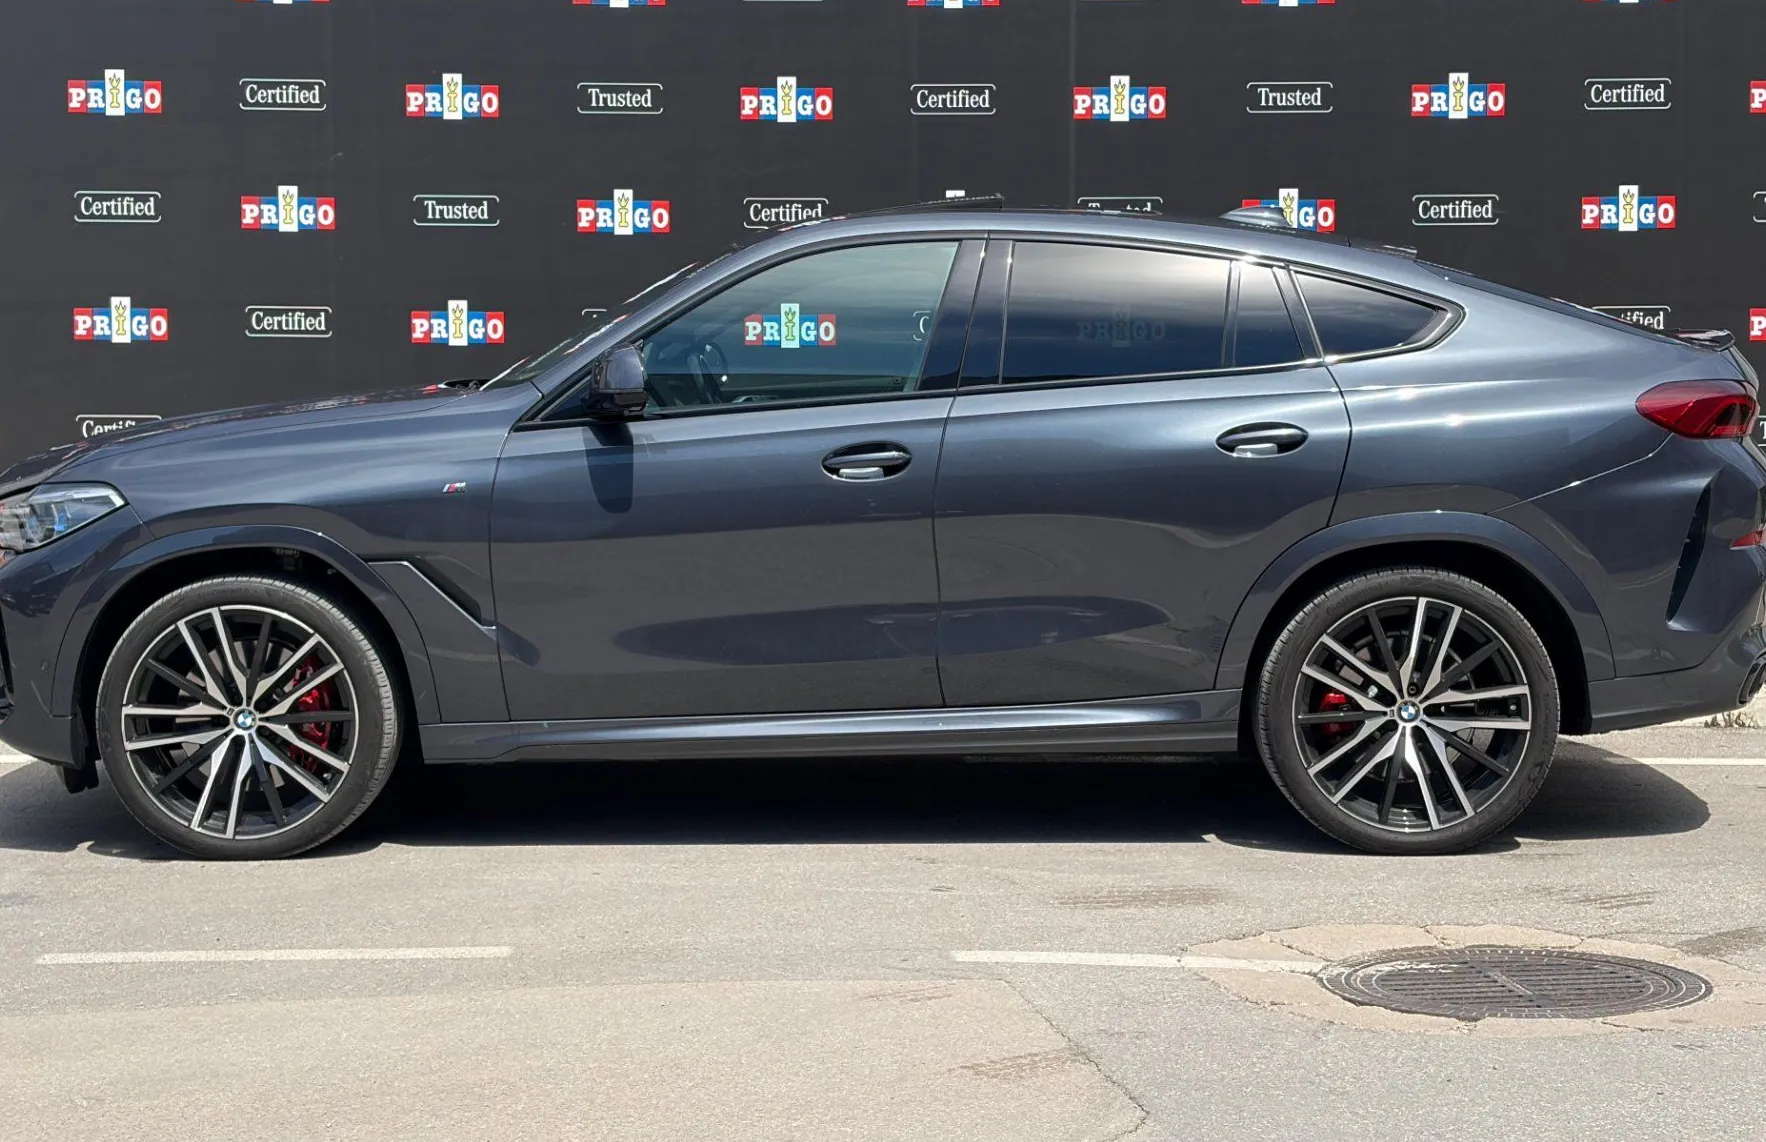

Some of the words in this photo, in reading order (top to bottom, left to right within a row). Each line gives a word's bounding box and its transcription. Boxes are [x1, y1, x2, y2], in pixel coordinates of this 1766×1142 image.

[68, 73, 161, 109] PRIGO
[246, 83, 320, 103] Certified
[407, 78, 498, 113] PRIGO
[588, 88, 652, 107] Trusted
[742, 81, 832, 115] PRIGO
[916, 89, 989, 108] Certified
[1075, 80, 1165, 115] PRIGO
[1258, 87, 1321, 106] Trusted
[1412, 77, 1504, 112] PRIGO
[1591, 83, 1665, 103] Certified
[80, 196, 155, 215] Certified
[242, 190, 334, 225] PRIGO
[424, 200, 488, 219] Trusted
[578, 193, 668, 228] PRIGO
[1418, 199, 1492, 218] Certified
[1582, 189, 1674, 225] PRIGO
[75, 301, 167, 336] PRIGO
[251, 310, 325, 330] Certified
[412, 304, 503, 339] PRIGO
[745, 307, 835, 341] PRIGO
